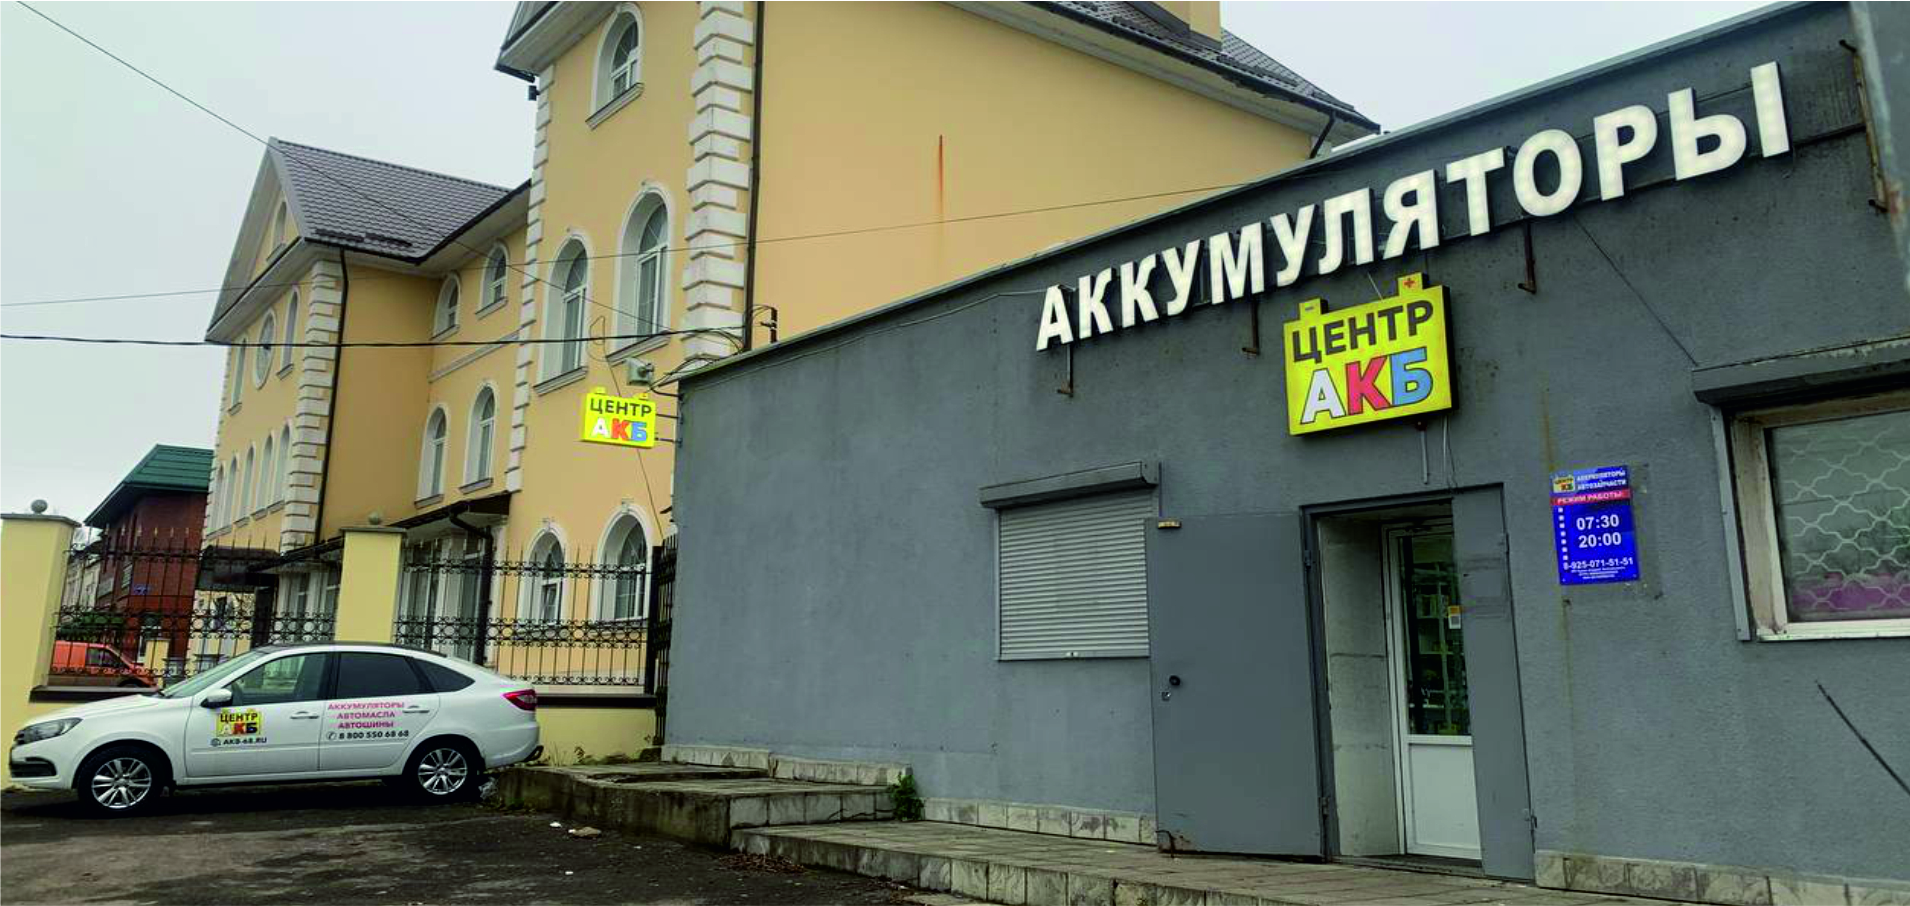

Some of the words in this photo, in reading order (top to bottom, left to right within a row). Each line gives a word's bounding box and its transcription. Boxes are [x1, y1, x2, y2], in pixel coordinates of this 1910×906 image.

[1034, 60, 1793, 353] АККУМУЛЯТОРЫ
[1292, 300, 1434, 364] ЦЕНТР
[1300, 346, 1434, 425] АКБ
[590, 398, 652, 417] ЦЕНТР
[590, 416, 647, 442] АКБ
[1557, 495, 1586, 505] РЕЖИМ
[1576, 514, 1620, 531] 07:30
[1578, 532, 1622, 549] 20:00
[328, 702, 404, 711] АККУМУЛЯТОРЫ
[220, 712, 258, 724] ЦЕНТР
[337, 711, 396, 720] АВТОМАСЛА
[220, 722, 258, 735] АКБ
[337, 721, 394, 729] АВТОШИНЫ
[339, 732, 345, 740] 8
[346, 731, 365, 740] 800
[366, 730, 383, 739] 550
[384, 730, 397, 738] 68
[397, 729, 410, 738] 68
